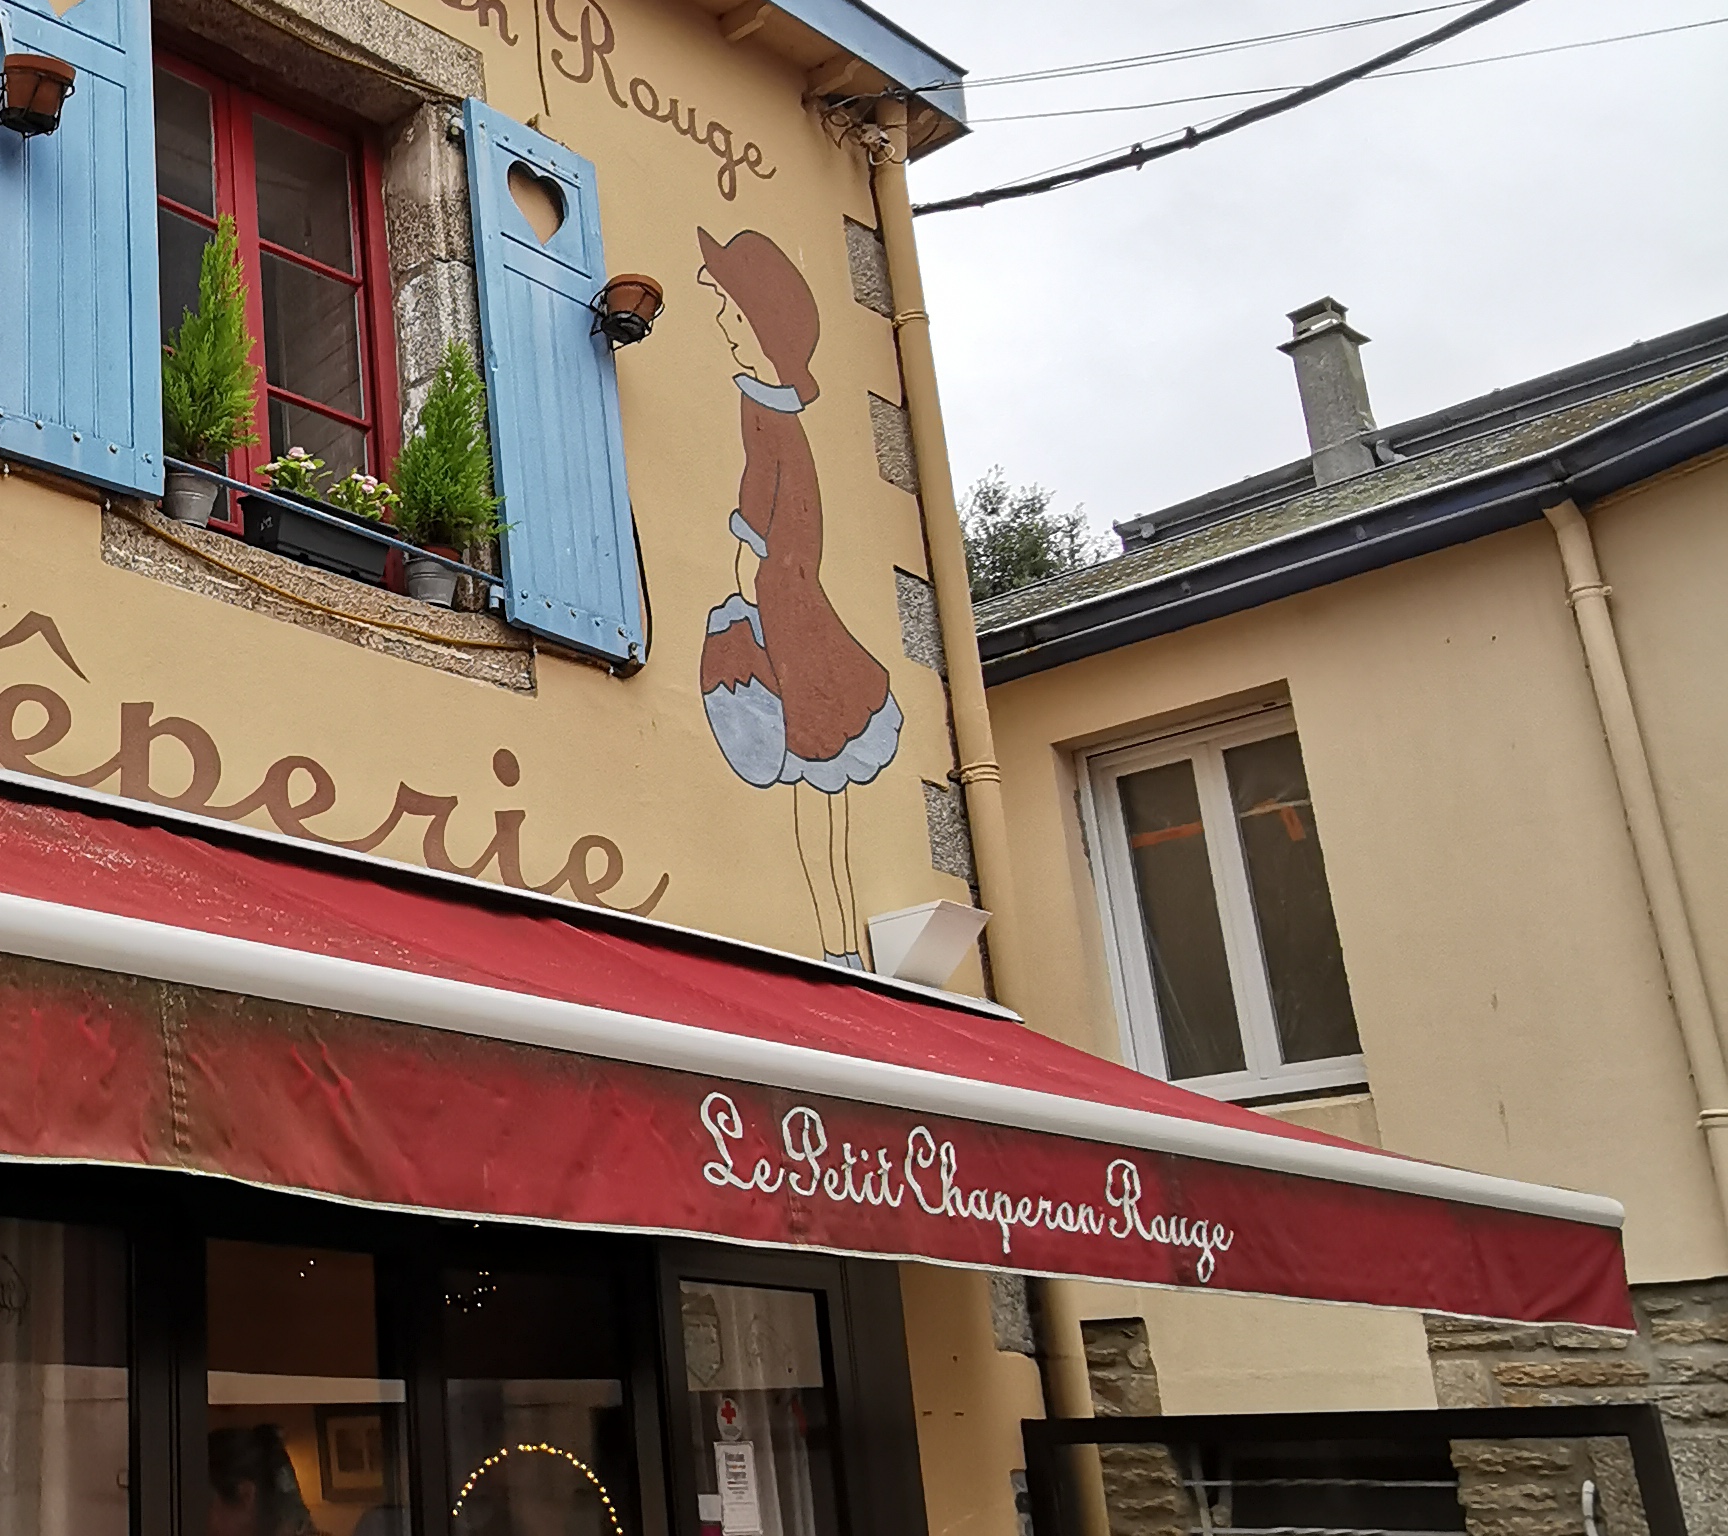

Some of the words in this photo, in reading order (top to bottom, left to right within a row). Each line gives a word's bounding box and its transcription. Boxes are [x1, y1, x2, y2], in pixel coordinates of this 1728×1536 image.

[700, 1091, 783, 1193] Le
[783, 1106, 904, 1207] Petit
[904, 1125, 1106, 1254] Chaperon
[1106, 1158, 1234, 1283] Rouge
